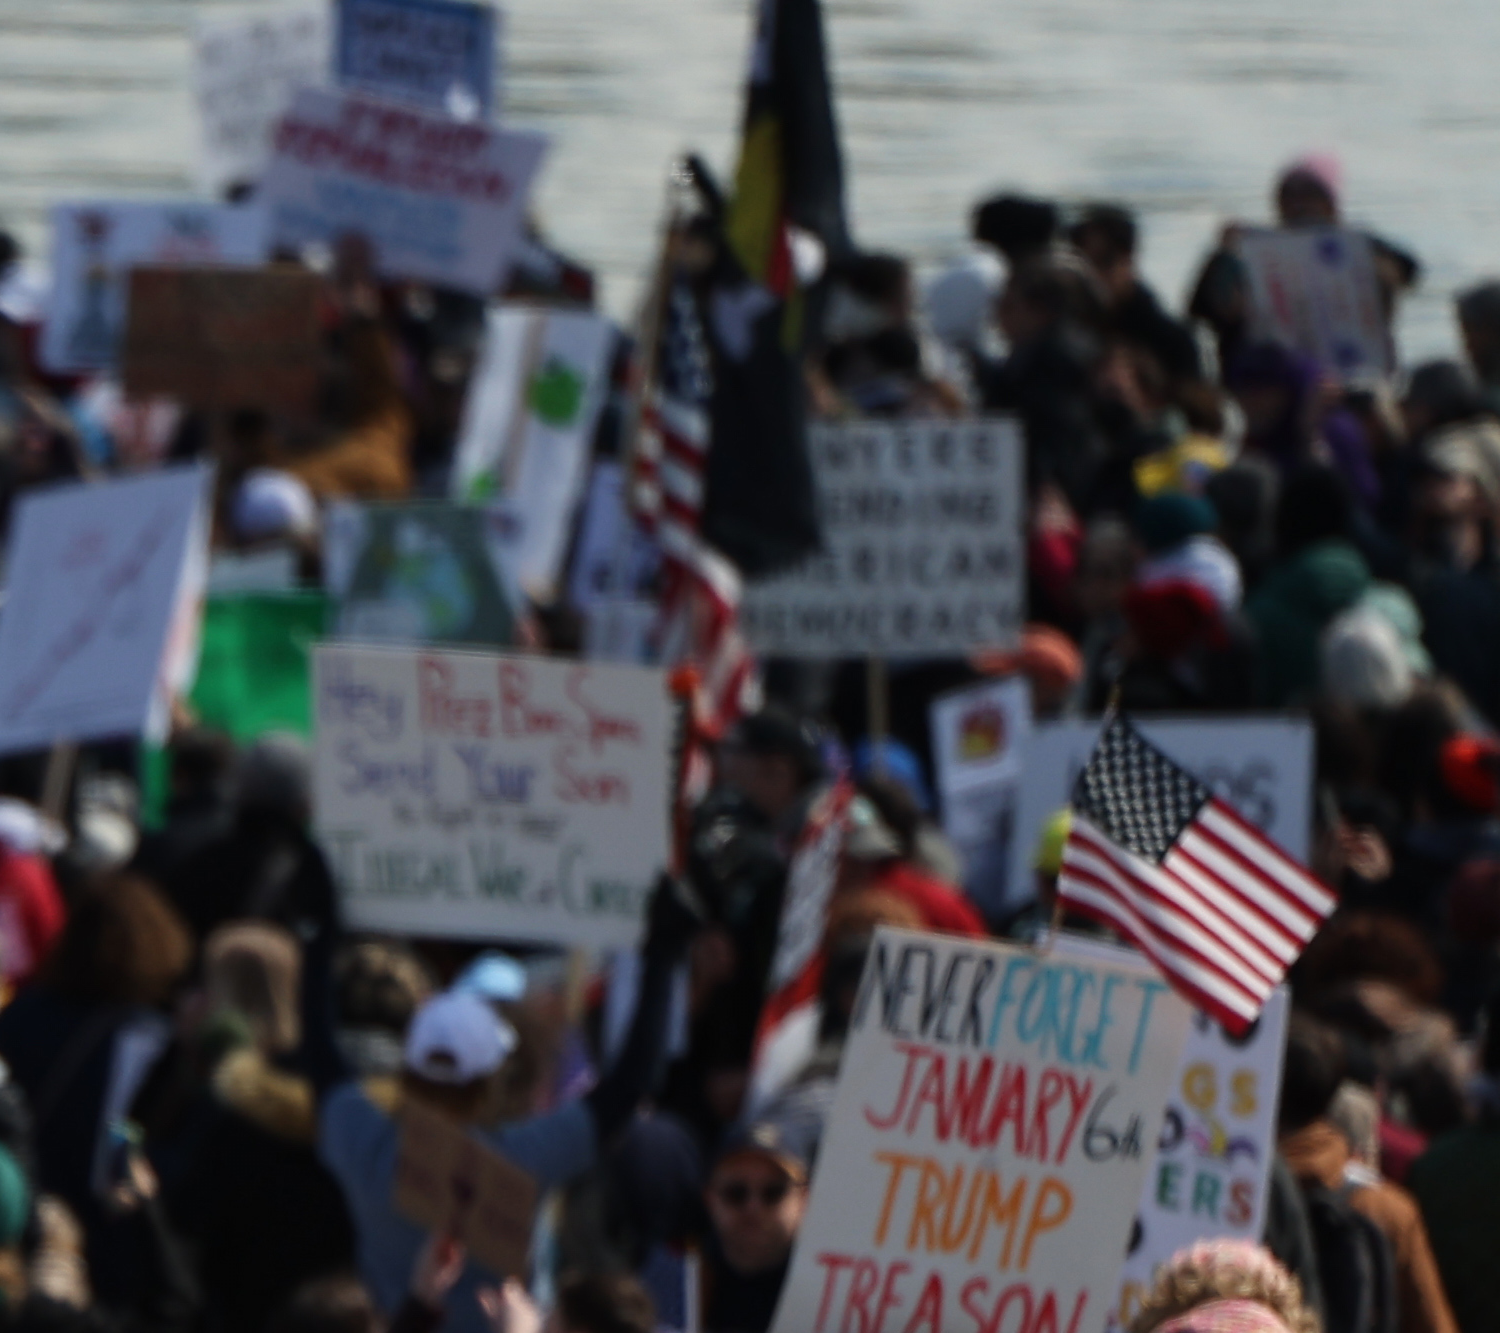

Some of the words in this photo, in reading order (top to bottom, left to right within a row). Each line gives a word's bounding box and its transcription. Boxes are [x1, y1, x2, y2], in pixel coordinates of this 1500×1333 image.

[856, 941, 995, 1052] NEVER
[988, 953, 1166, 1075] FORGET
[863, 1040, 1096, 1168] JANUARY
[873, 1149, 1076, 1270] TRUMP
